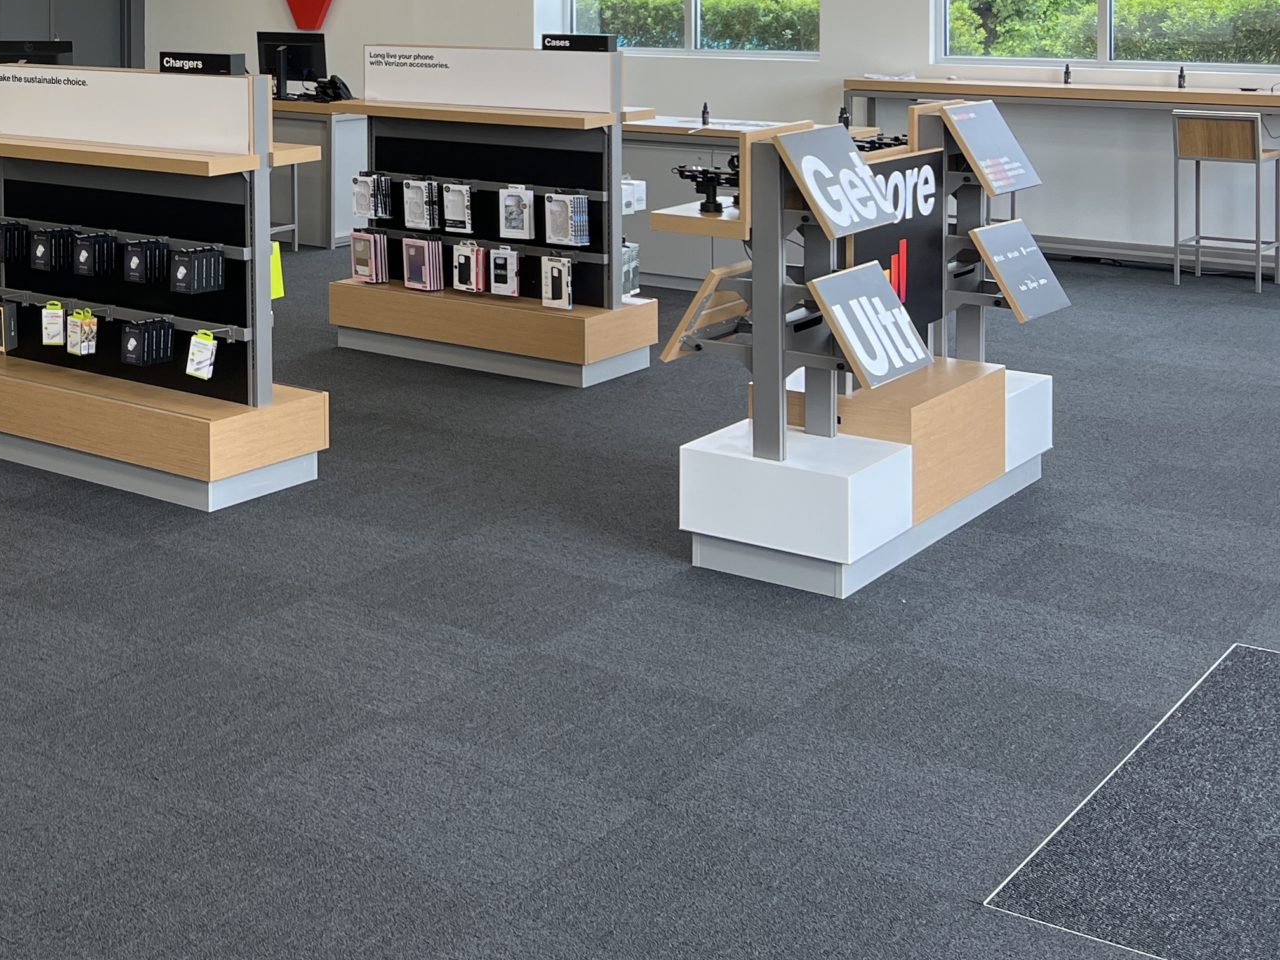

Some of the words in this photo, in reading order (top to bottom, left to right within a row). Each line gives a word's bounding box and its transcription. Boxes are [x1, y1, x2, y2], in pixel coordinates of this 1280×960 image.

[544, 38, 570, 47] Cases
[369, 52, 386, 60] Long
[413, 53, 435, 61] phone
[163, 57, 203, 70] Chargers
[11, 74, 23, 83] the
[23, 75, 62, 85] sustainable
[62, 77, 89, 86] choice.
[801, 152, 895, 227] Get
